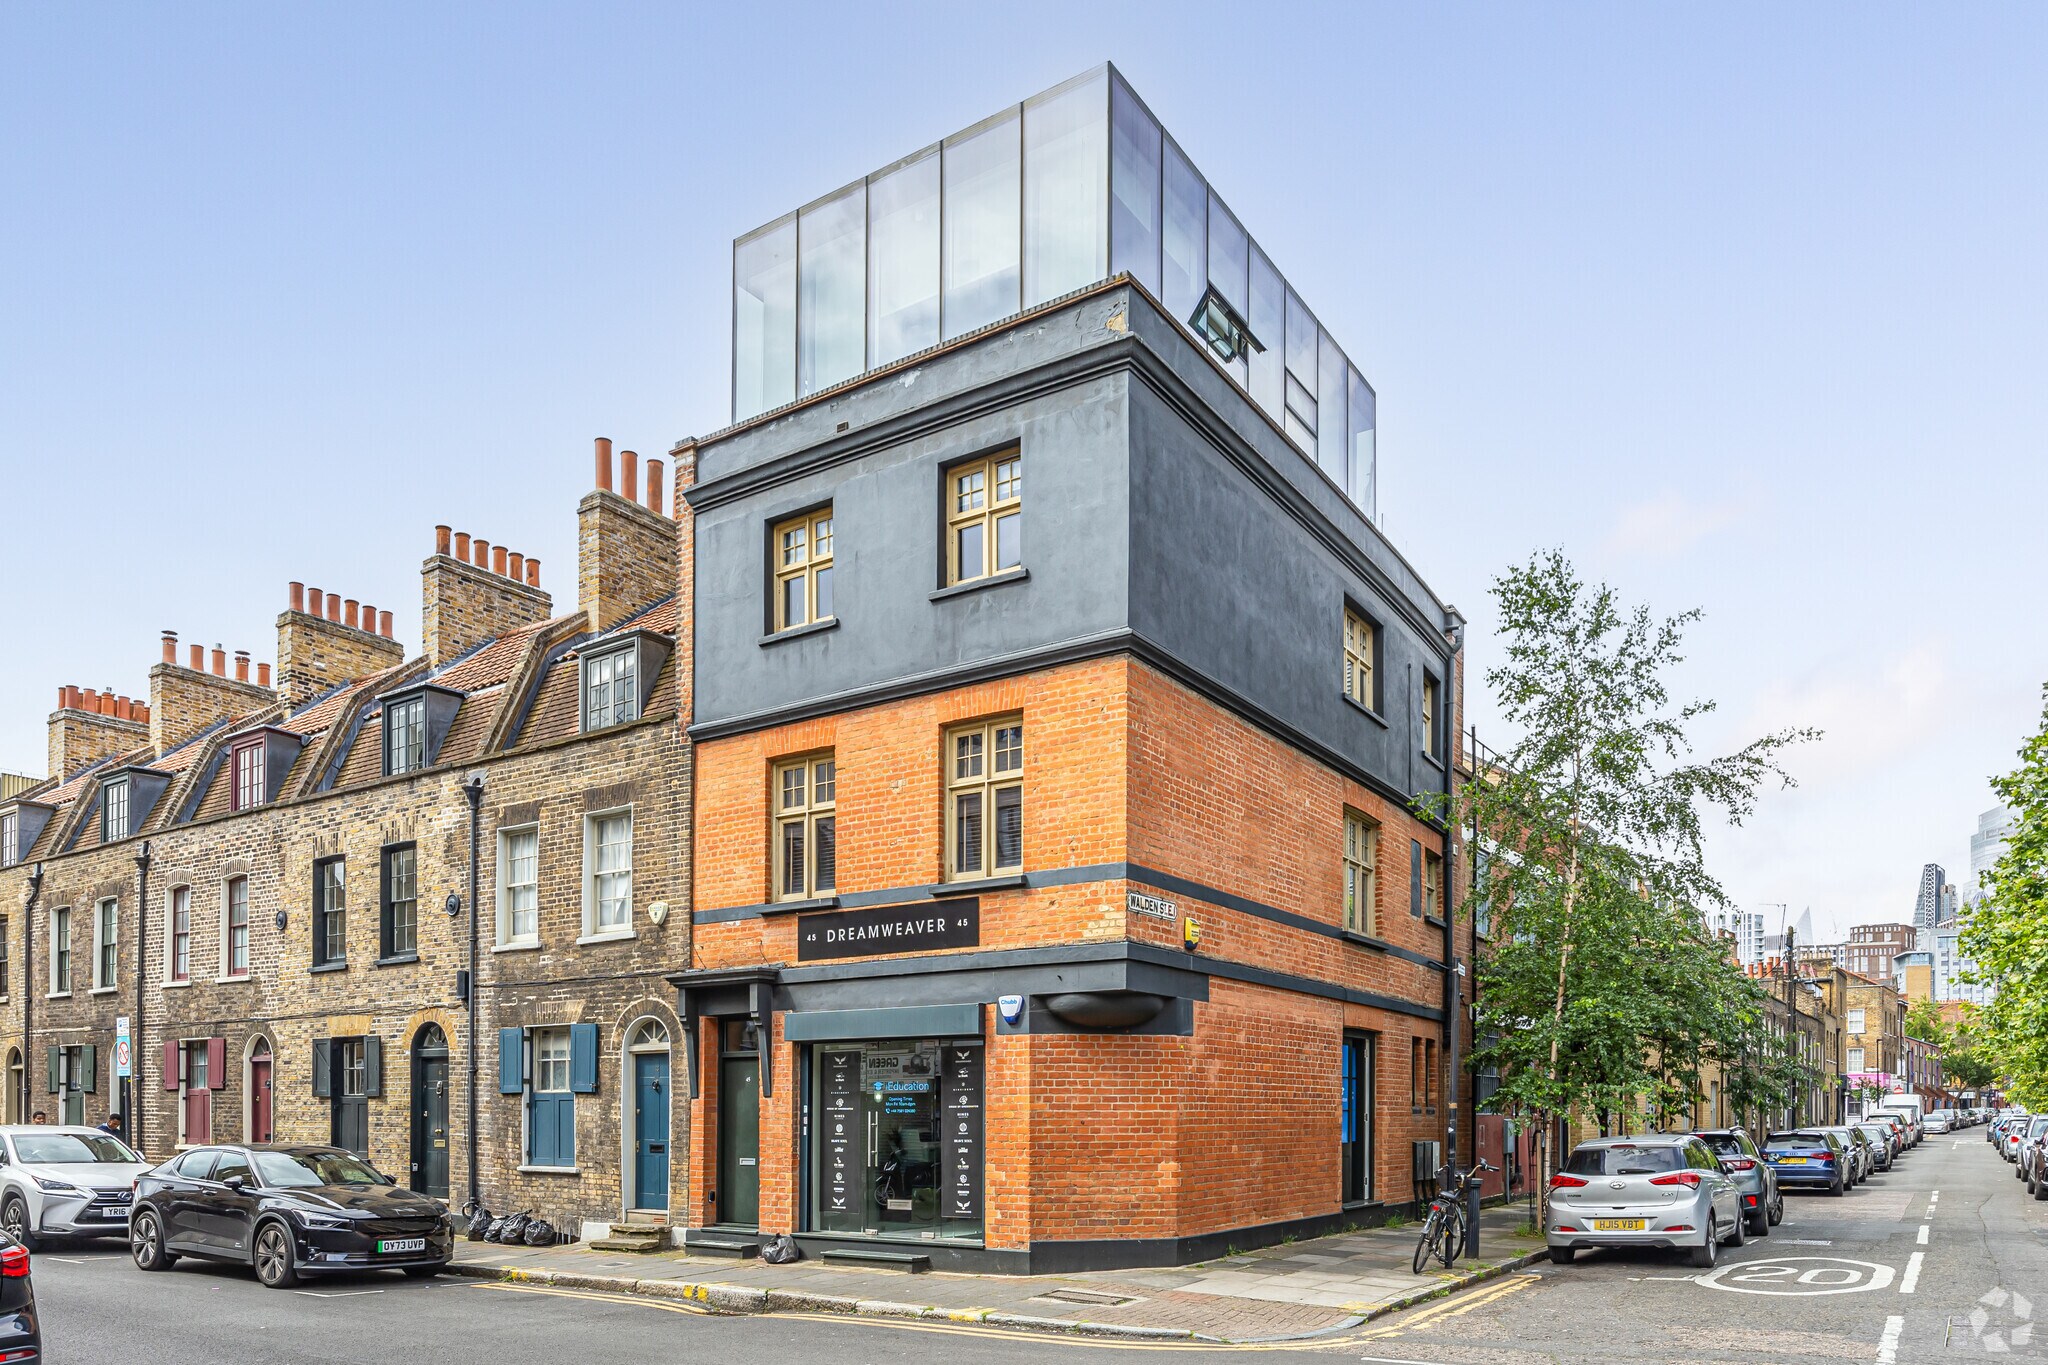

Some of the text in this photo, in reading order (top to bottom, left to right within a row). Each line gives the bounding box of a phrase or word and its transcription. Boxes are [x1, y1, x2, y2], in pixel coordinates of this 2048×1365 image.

[1130, 895, 1158, 914] WALDEN
[827, 918, 946, 943] DREAMWEAVER
[957, 918, 968, 927] 45
[885, 1080, 930, 1091] iEducation
[108, 1208, 126, 1216] YR16
[1599, 1220, 1640, 1229] HJ15 VBT
[384, 1240, 424, 1251] OY73 UVP
[1731, 1266, 1863, 1285] 20
